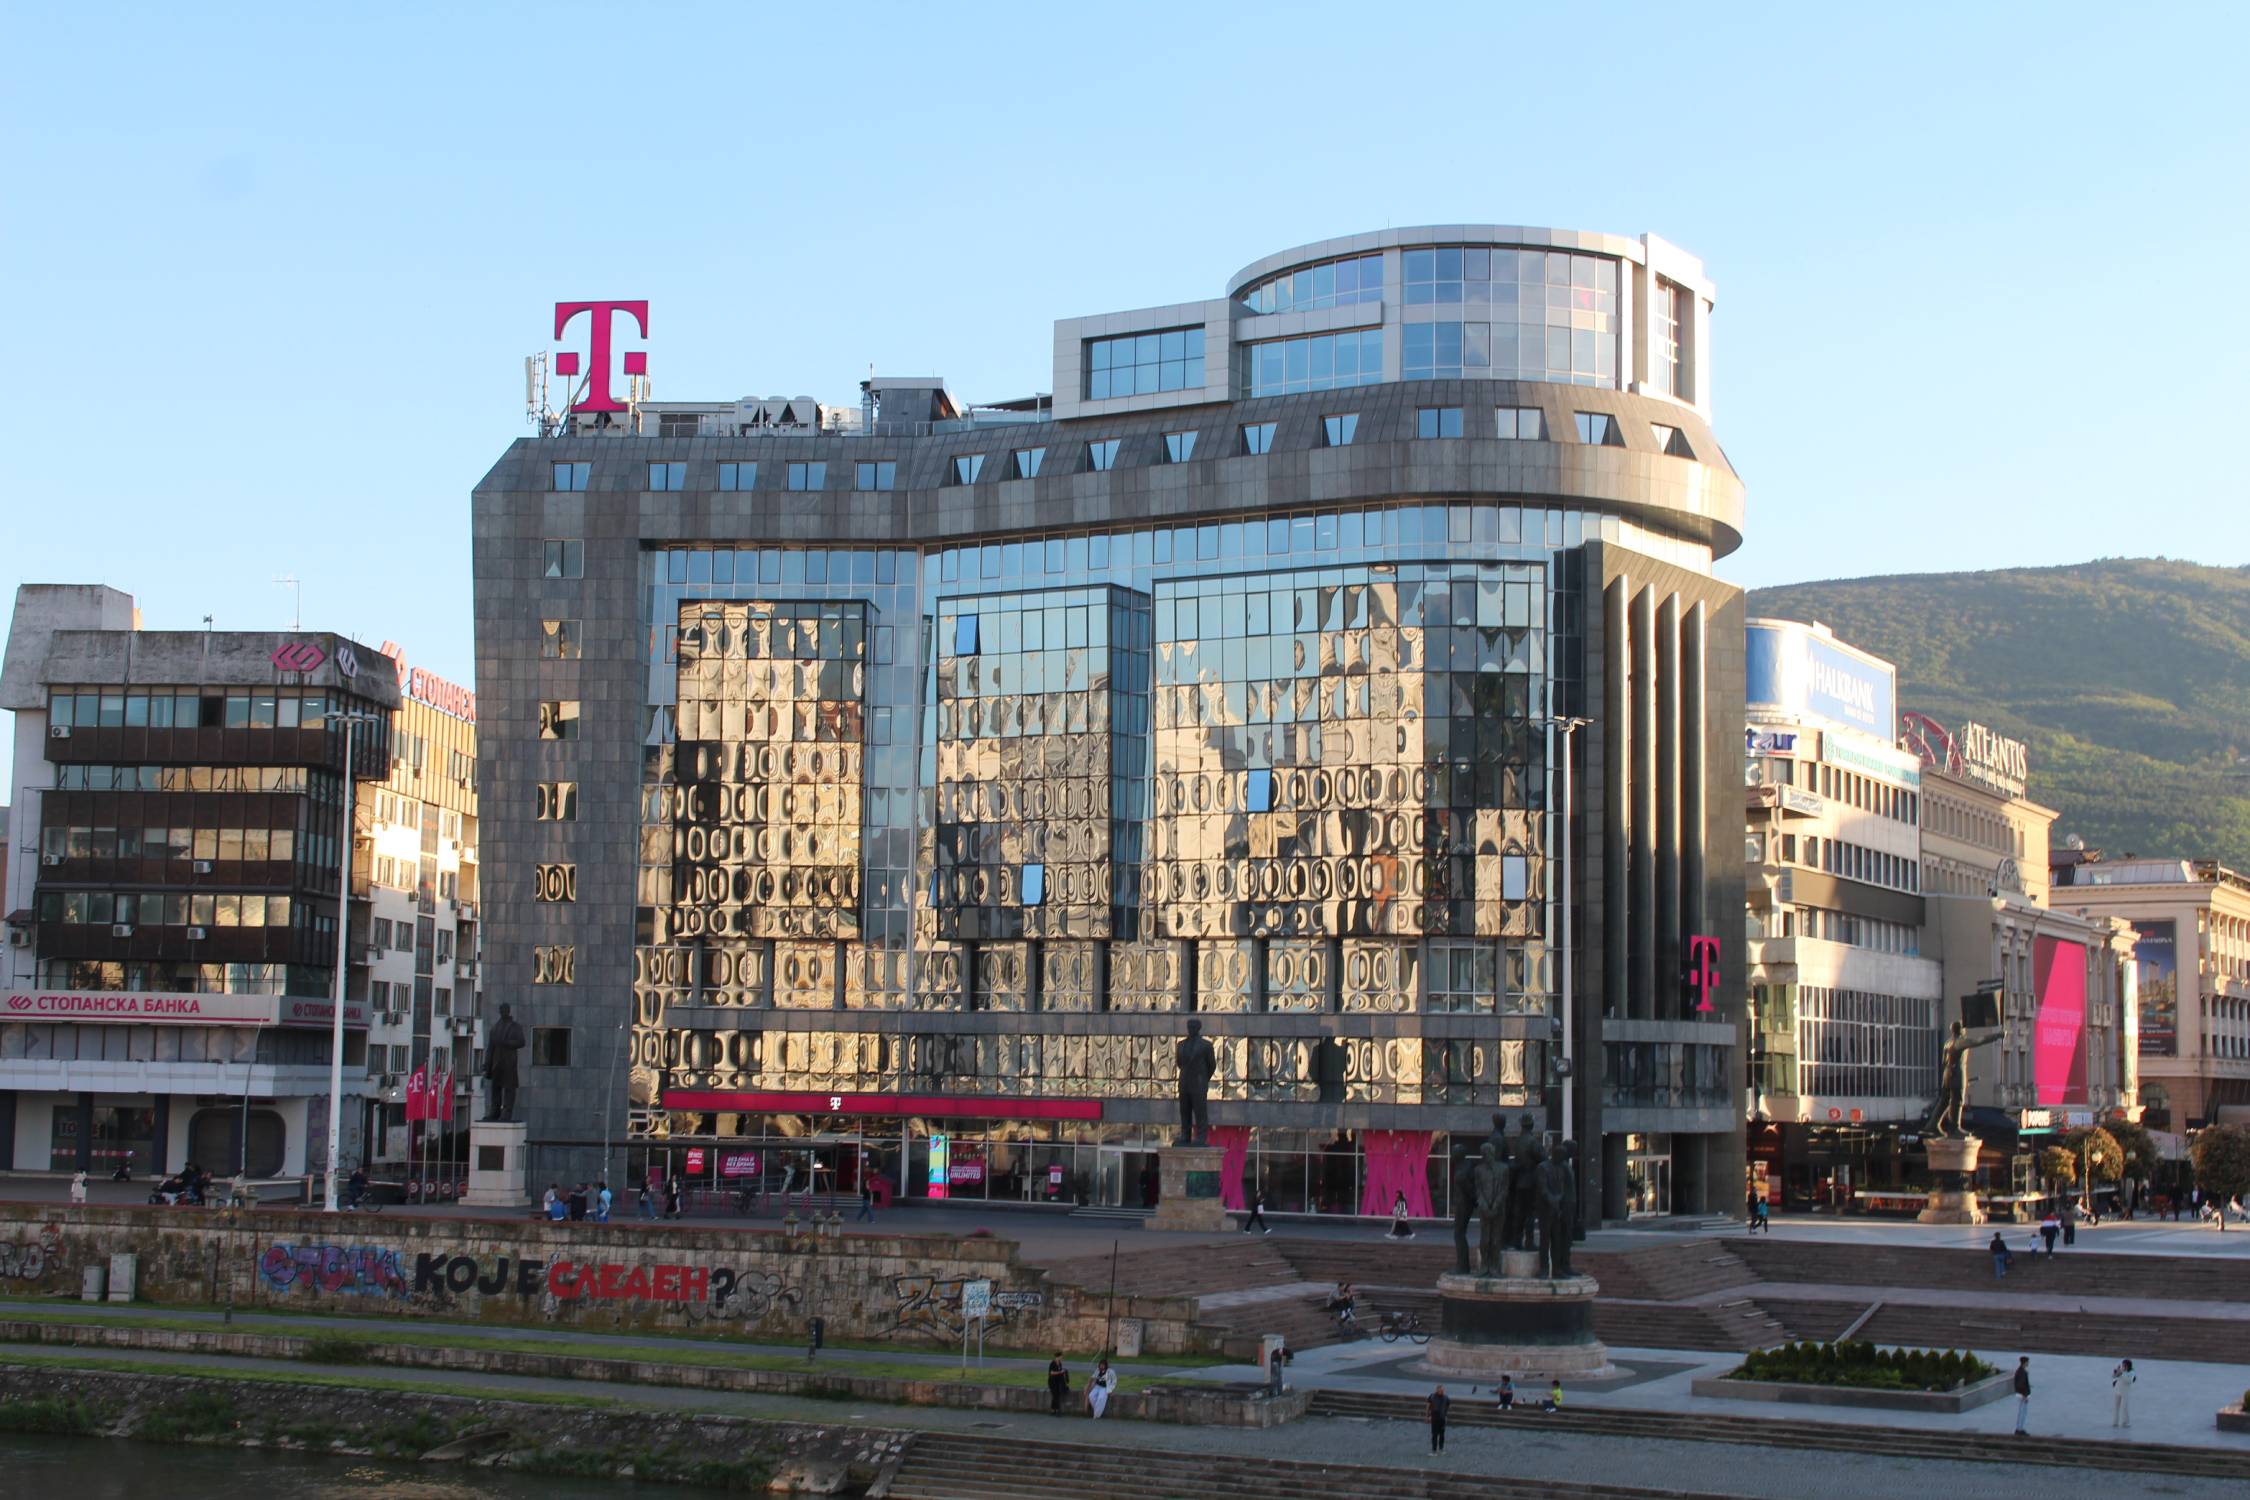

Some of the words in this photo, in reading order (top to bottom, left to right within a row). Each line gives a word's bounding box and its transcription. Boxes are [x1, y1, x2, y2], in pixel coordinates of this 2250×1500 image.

[554, 300, 648, 413] T
[1815, 660, 1875, 713] HALKBANK
[1965, 720, 2027, 780] ATLANTIS
[1690, 935, 1720, 1011] T
[37, 996, 138, 1012] СТОПАНСКА
[143, 999, 201, 1013] БАНКА
